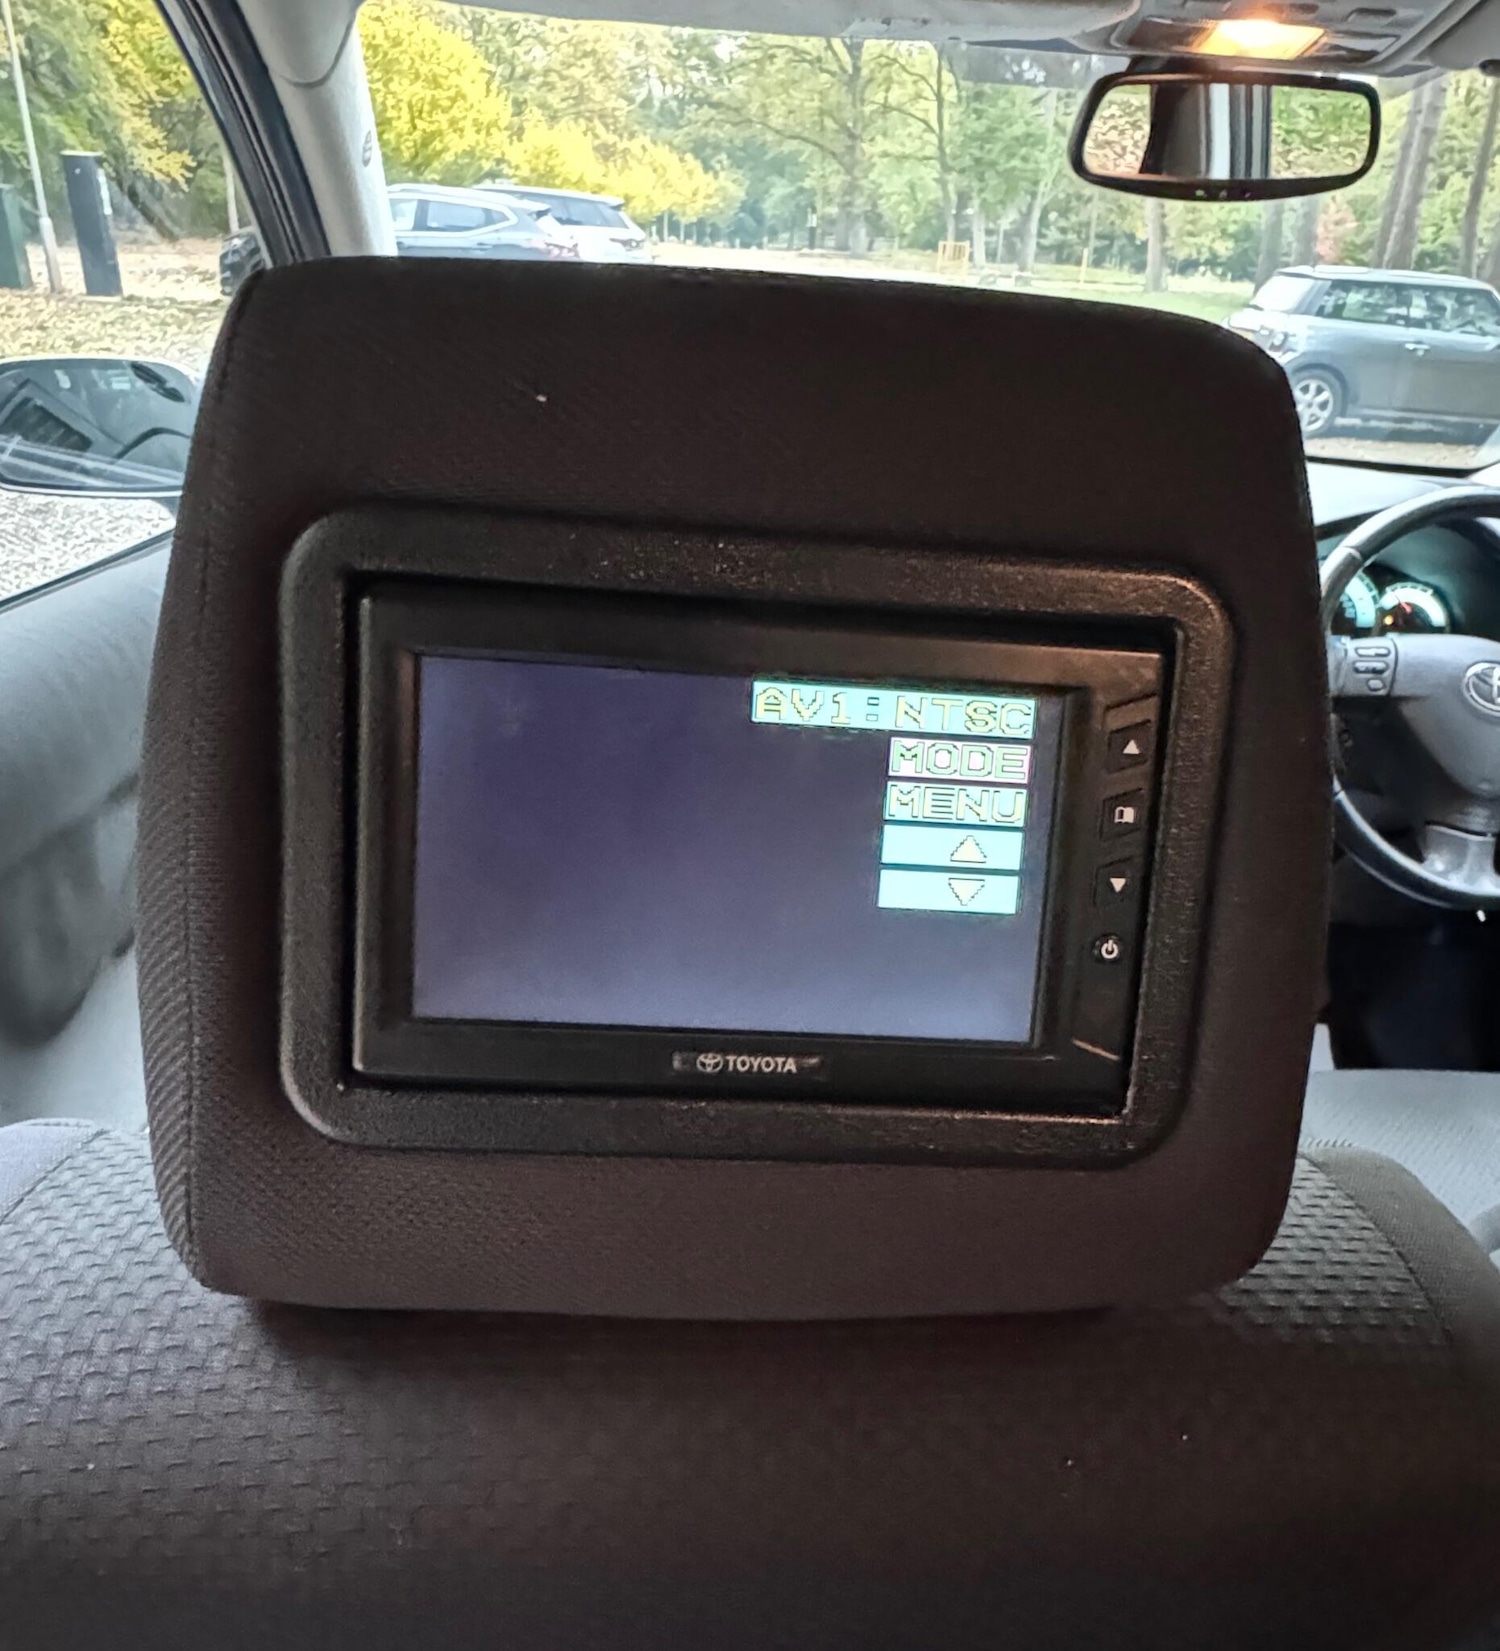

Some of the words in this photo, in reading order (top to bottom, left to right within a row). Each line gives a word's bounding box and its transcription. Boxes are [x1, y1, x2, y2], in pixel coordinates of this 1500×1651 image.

[891, 740, 1028, 780] MODE
[888, 784, 1024, 823] MENU
[725, 1055, 798, 1073] TOYOTA
